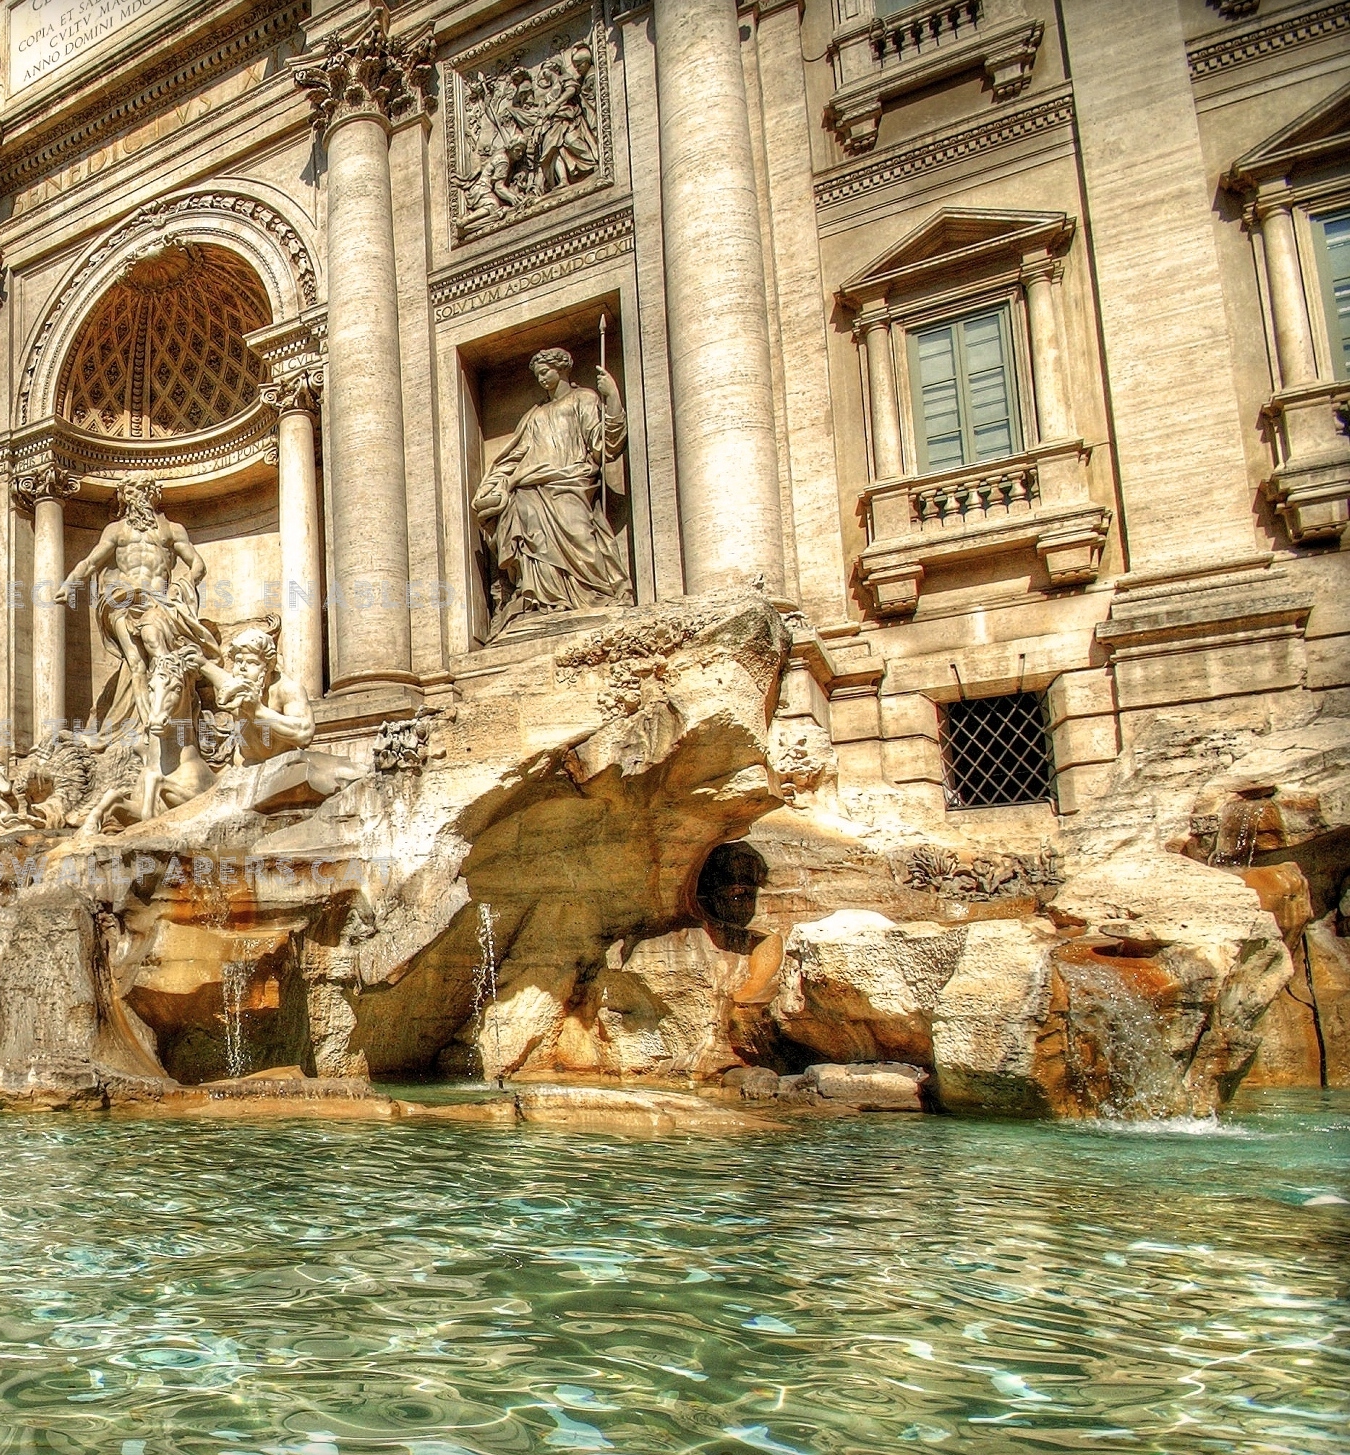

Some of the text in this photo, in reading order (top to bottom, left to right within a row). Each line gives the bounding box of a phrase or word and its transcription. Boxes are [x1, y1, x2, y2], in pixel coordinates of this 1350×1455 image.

[18, 23, 55, 53] COPIA
[60, 7, 75, 27] ET
[23, 50, 61, 83] ANNO
[64, 16, 114, 57] DOMINI
[49, 12, 92, 48] CVLTV
